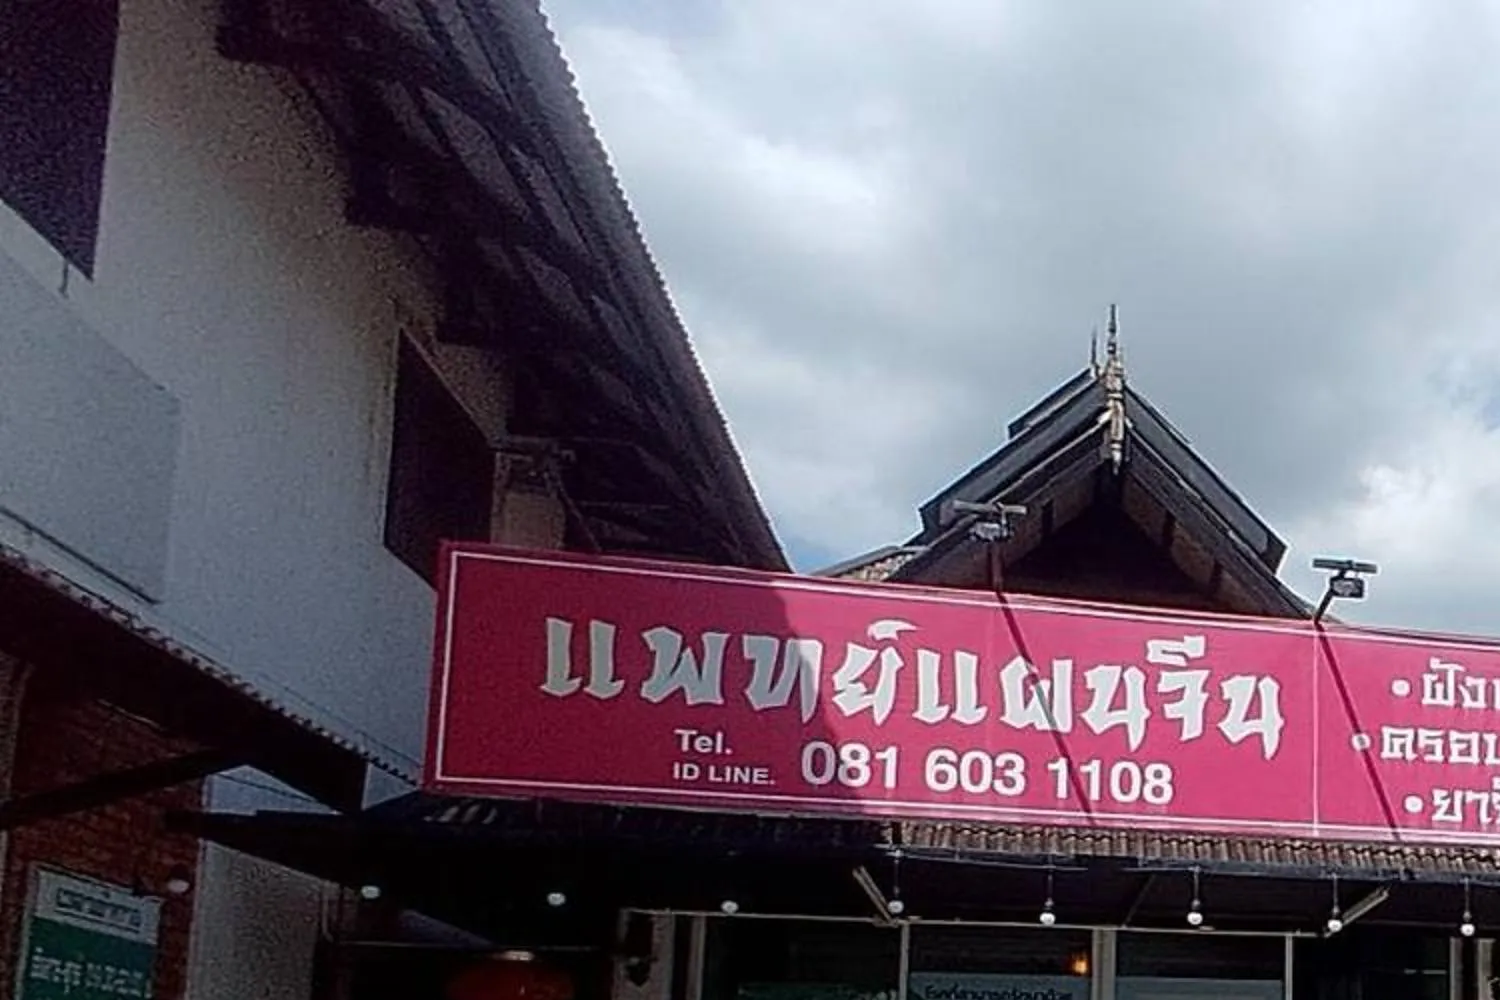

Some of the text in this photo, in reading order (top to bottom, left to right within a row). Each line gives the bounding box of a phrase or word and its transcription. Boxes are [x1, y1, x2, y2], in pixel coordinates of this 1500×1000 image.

[541, 616, 1284, 759] แพทย์แผนจีน
[674, 730, 732, 755] Tel.
[673, 762, 777, 785] ID LINE.
[802, 742, 1173, 805] 081 603 1108
